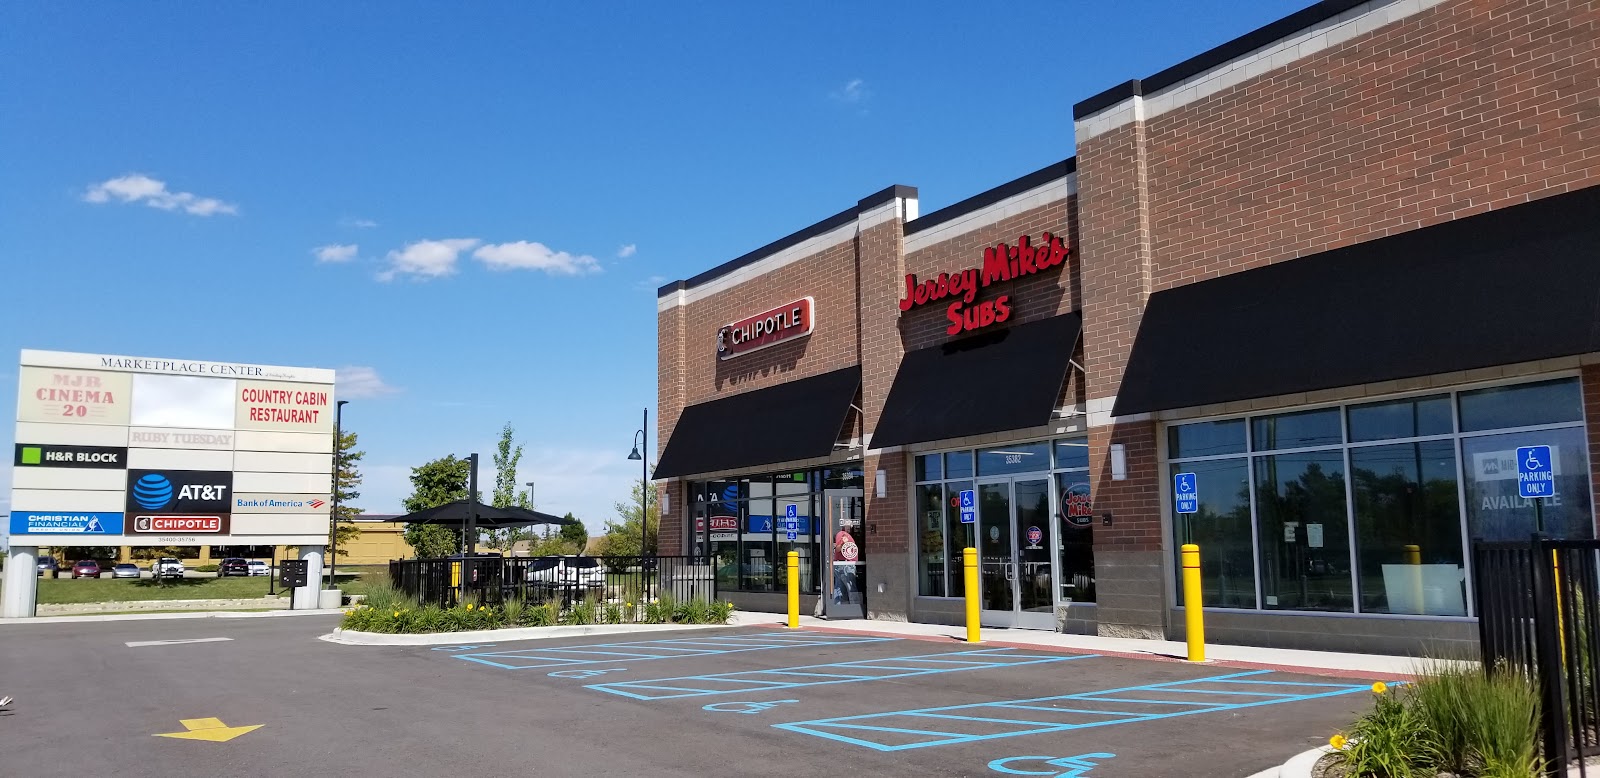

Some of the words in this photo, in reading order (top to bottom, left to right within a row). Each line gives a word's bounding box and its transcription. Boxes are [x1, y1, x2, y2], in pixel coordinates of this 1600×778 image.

[899, 273, 977, 311] Jersey
[982, 231, 1070, 288] Mike's
[732, 307, 800, 345] CHIPOTLE
[101, 357, 206, 373] MARKETPLACE
[210, 364, 262, 377] CENTER
[53, 374, 102, 387] MJR
[36, 387, 114, 404] CINEMA
[242, 388, 293, 405] COUNTRY
[295, 391, 327, 406] CABIN
[62, 404, 87, 417] 20
[250, 407, 319, 424] RESTAURANT
[132, 431, 170, 443] RUBY
[172, 433, 232, 445] TUESDAY
[46, 451, 73, 462] H&R
[76, 452, 118, 463] BLOCK
[1519, 471, 1552, 482] PARKING
[177, 484, 227, 501] AT&T
[1526, 483, 1546, 493] ONLY
[237, 499, 259, 507] Bank
[259, 499, 268, 507] of
[1176, 493, 1196, 501] PARKING
[1482, 493, 1562, 511] AVAILALE
[1180, 501, 1193, 510] ONLY
[154, 519, 217, 529] CHIPOTLE
